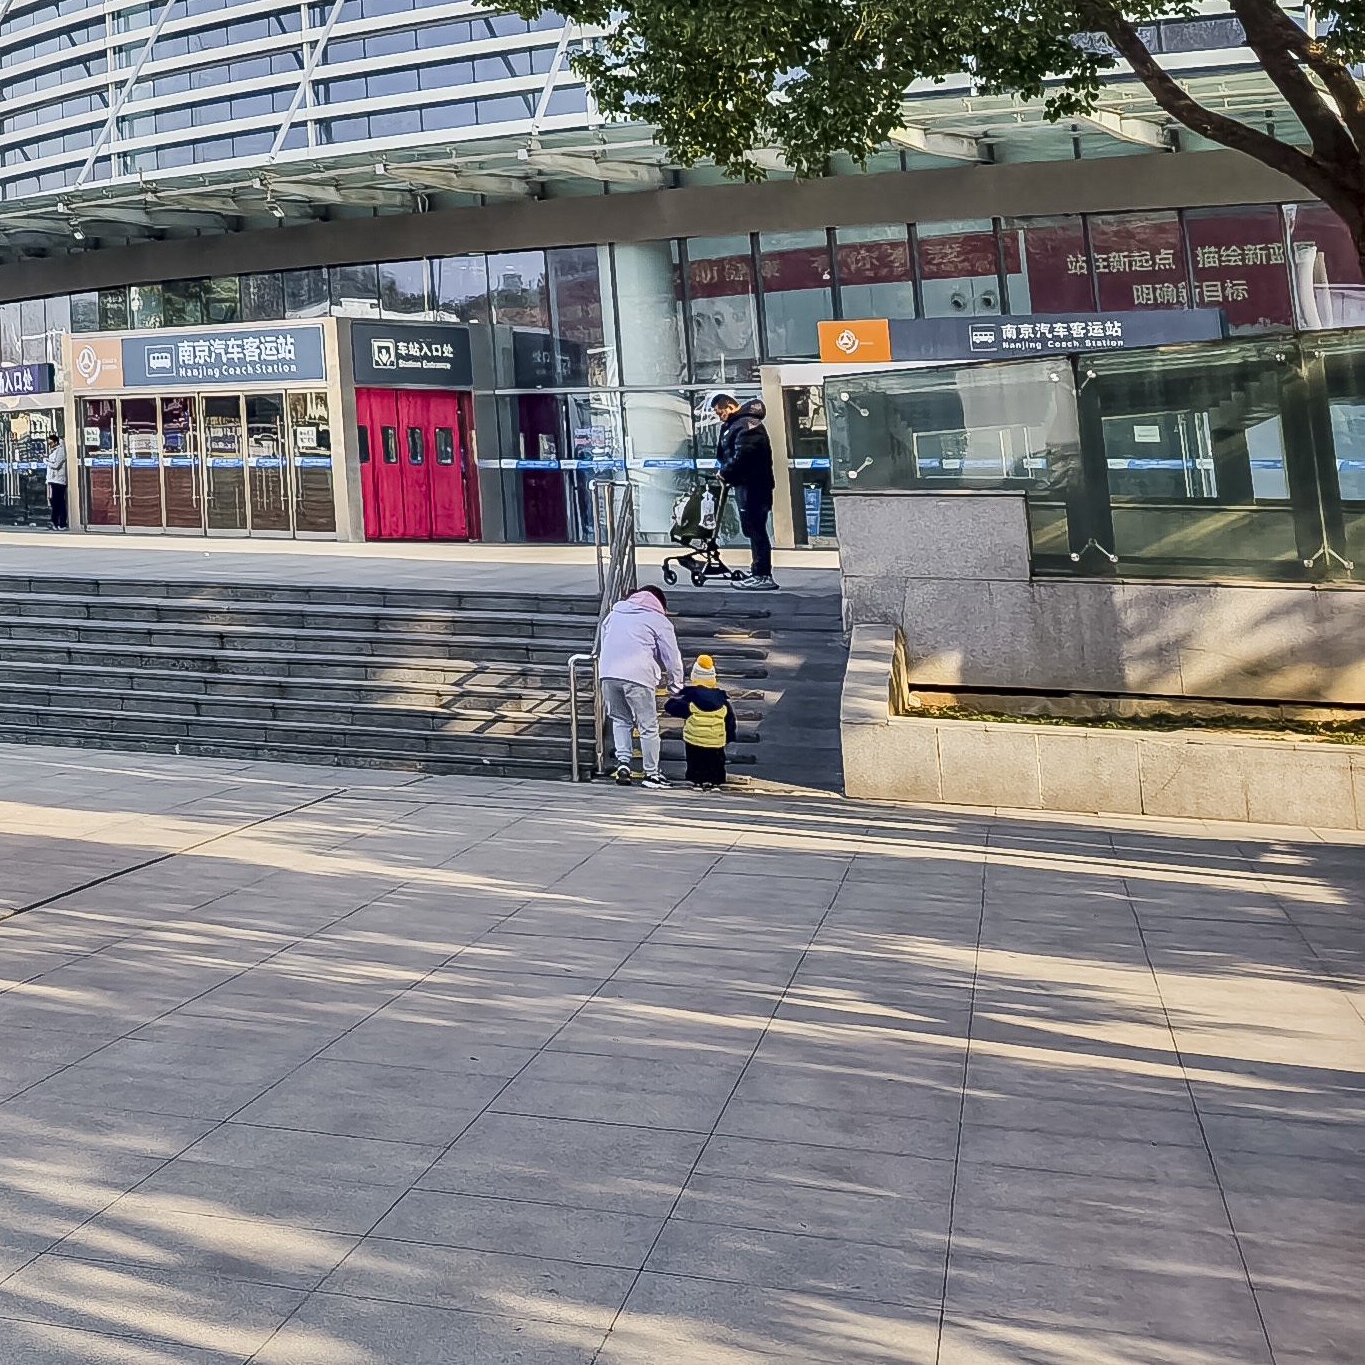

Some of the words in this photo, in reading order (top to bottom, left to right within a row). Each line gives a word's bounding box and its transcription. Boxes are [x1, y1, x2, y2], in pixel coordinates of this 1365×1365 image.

[1067, 248, 1176, 275] 站在新起点
[1132, 280, 1249, 305] 明确新目标
[1001, 321, 1123, 340] 南京汽车客运站
[178, 334, 296, 365] 南京汽车客运站
[397, 342, 454, 358] 车站入口处
[1002, 340, 1042, 350] Nanjing
[1047, 340, 1080, 349] Coach
[1085, 338, 1124, 347] Station
[179, 366, 220, 379] Nanjing
[222, 365, 253, 376] Coach
[255, 363, 297, 374] Station
